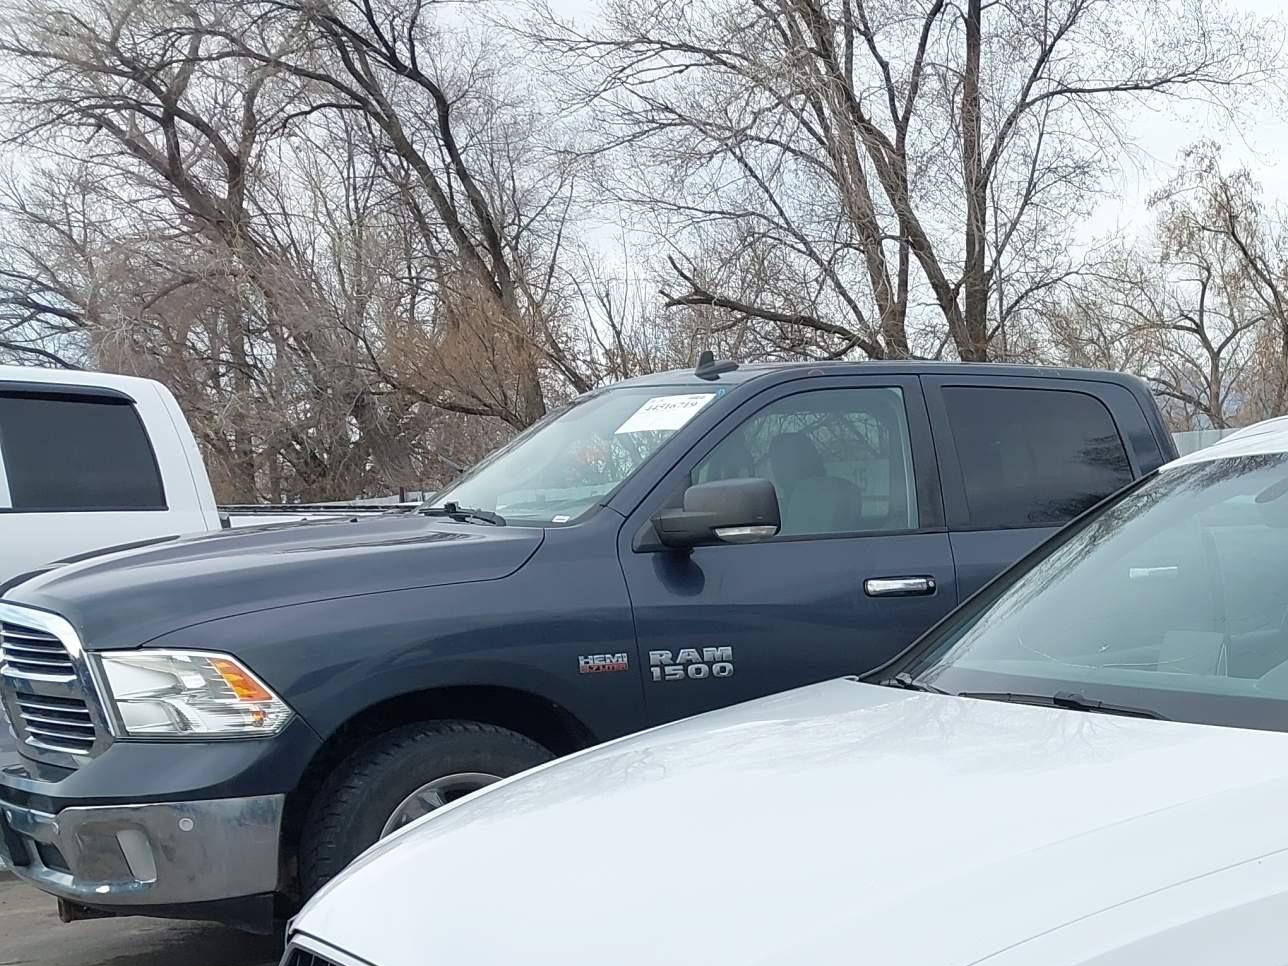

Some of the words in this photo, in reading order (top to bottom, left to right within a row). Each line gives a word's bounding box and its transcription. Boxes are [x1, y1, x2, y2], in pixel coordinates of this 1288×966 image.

[578, 653, 628, 665] HEMI
[649, 646, 733, 665] RAM
[650, 662, 734, 681] 1500
